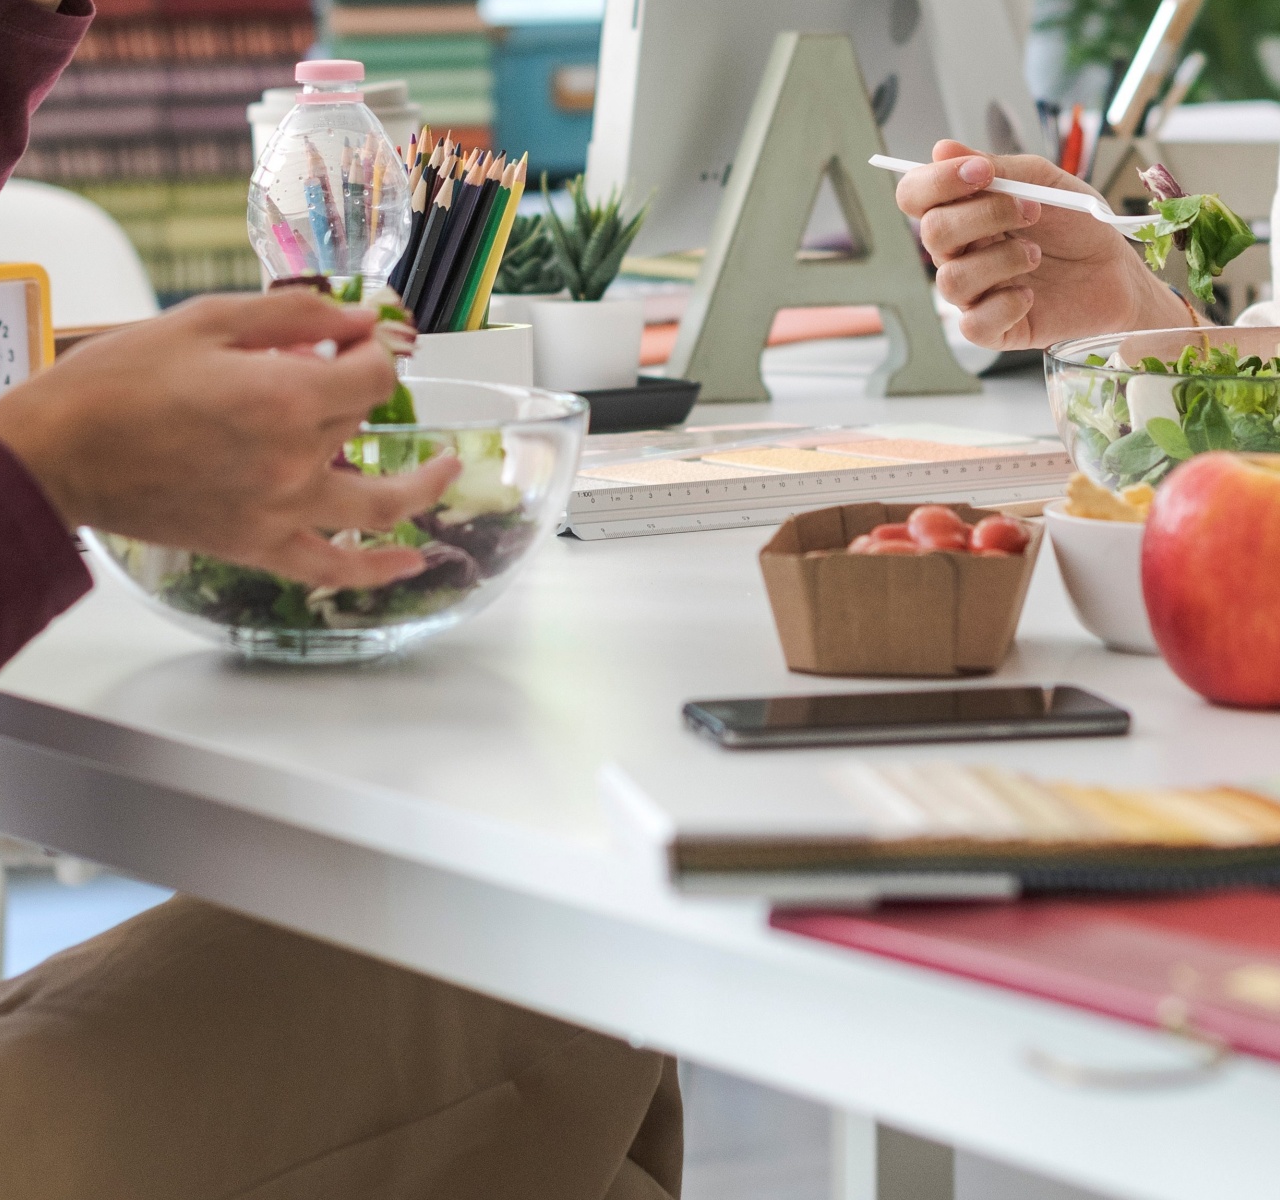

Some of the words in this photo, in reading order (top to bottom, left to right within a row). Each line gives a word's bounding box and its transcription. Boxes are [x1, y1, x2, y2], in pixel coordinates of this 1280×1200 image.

[665, 31, 983, 403] A
[3, 325, 9, 338] 2
[8, 349, 14, 362] 3
[4, 374, 10, 385] 4
